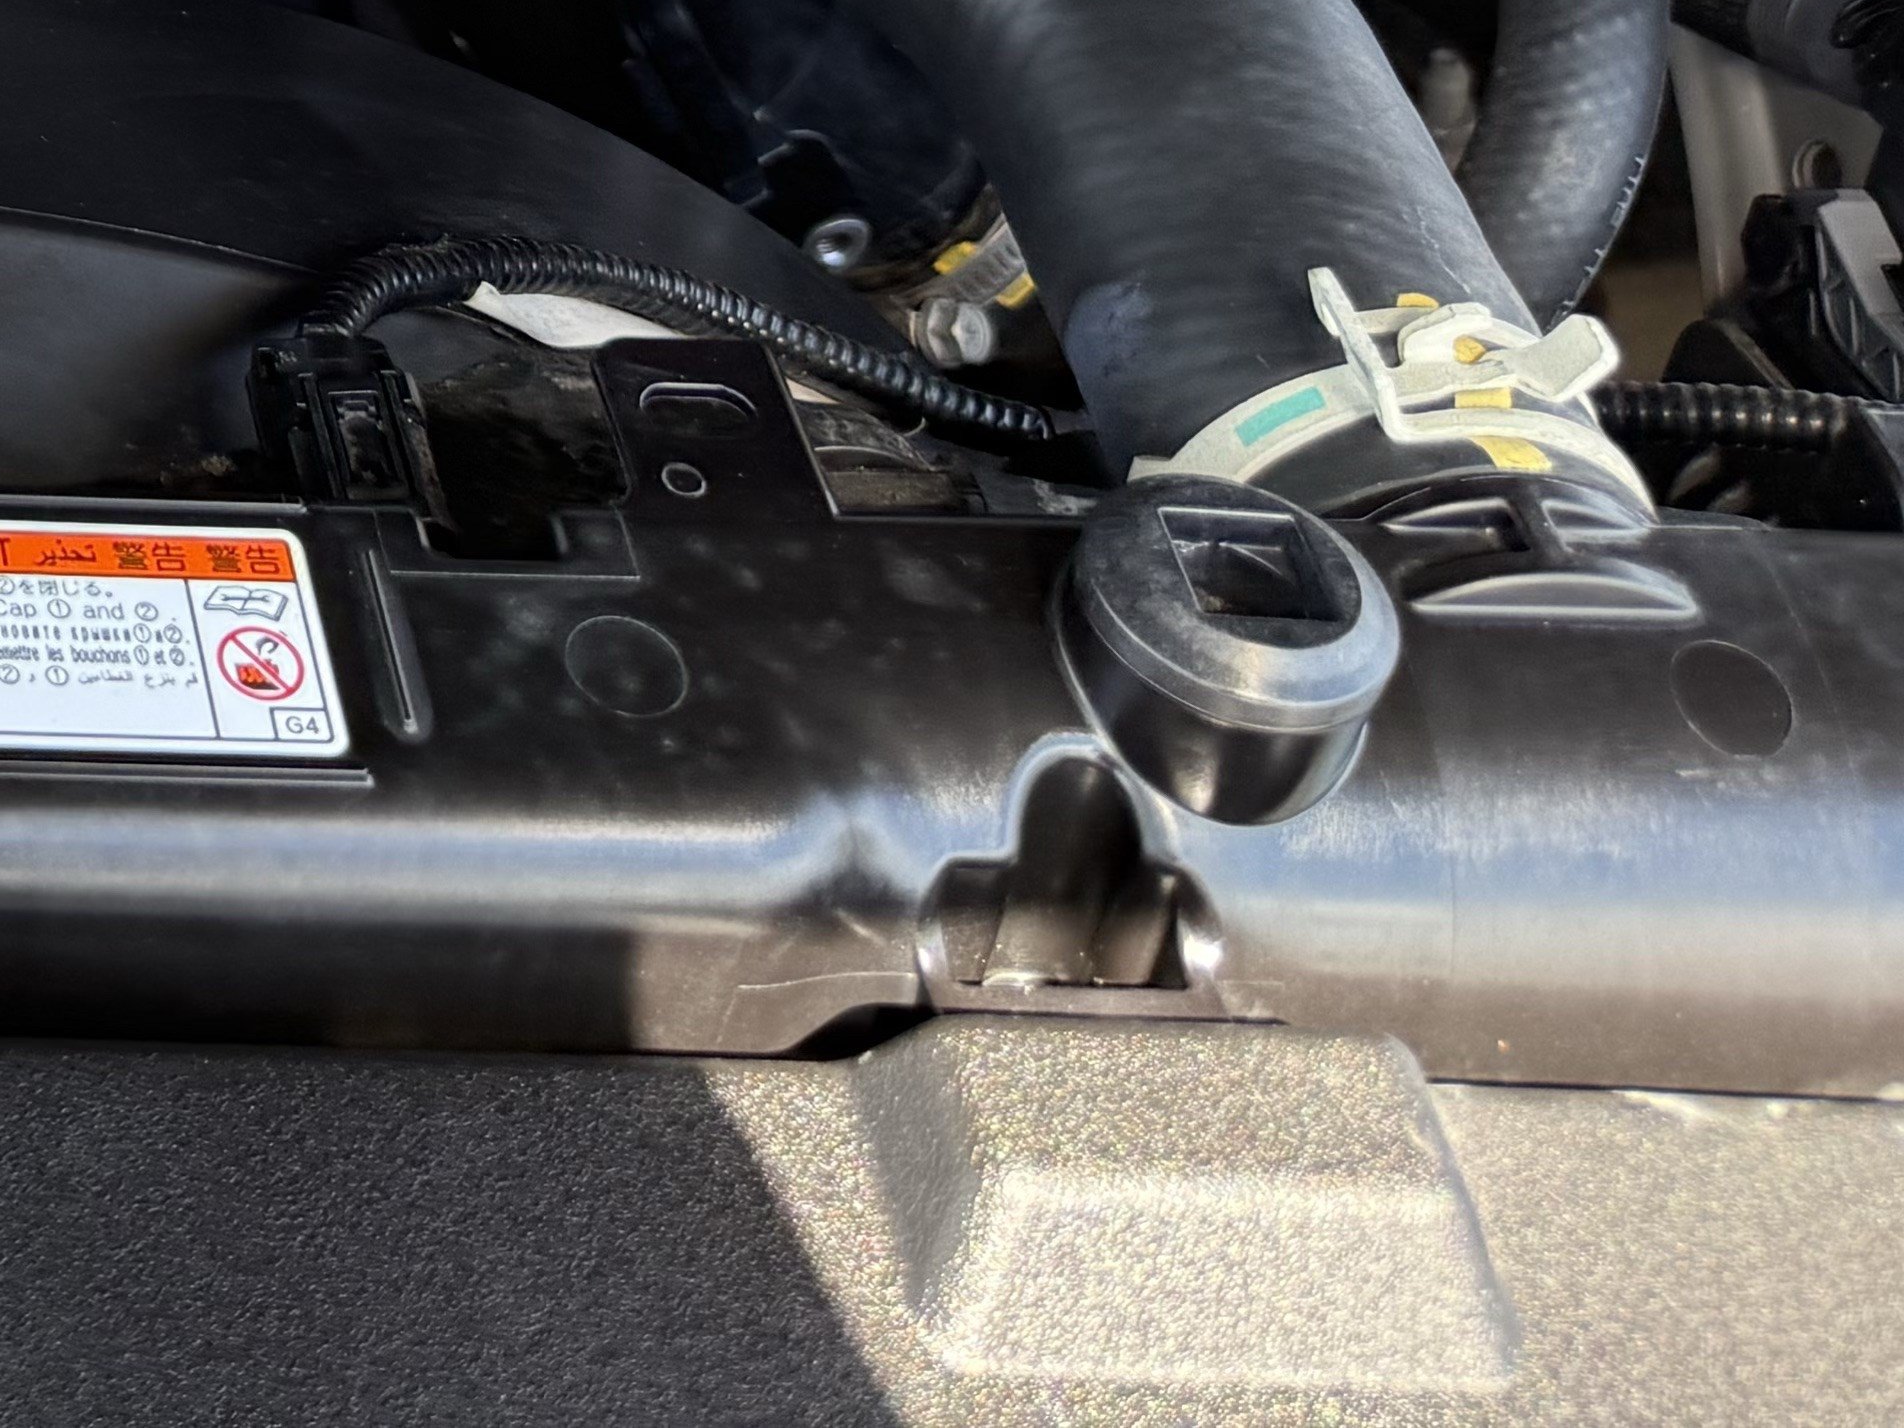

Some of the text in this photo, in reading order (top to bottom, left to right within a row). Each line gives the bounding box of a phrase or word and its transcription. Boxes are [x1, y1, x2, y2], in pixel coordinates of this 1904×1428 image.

[33, 540, 98, 567] تحذير
[112, 541, 188, 571] 警告
[205, 544, 282, 575] 警告
[83, 603, 125, 621] and
[284, 716, 319, 733] G4
